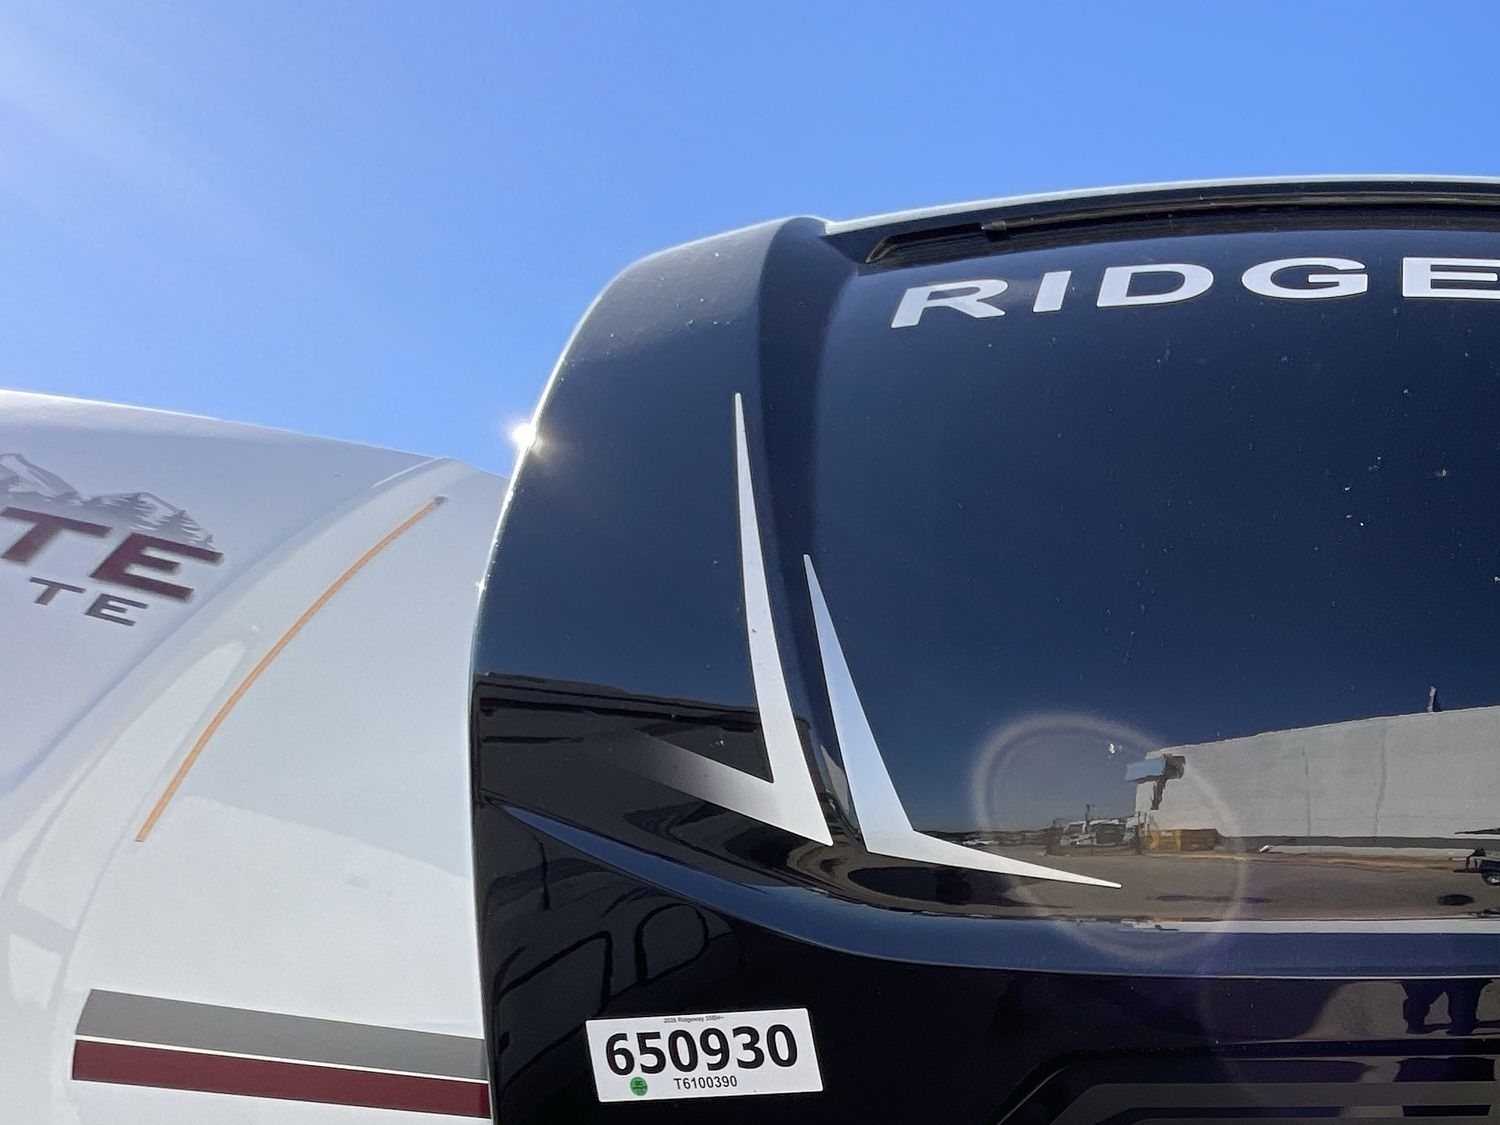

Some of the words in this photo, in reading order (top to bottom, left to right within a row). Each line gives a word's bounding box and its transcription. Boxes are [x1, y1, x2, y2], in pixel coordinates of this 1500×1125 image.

[0, 506, 225, 604] TE
[29, 576, 151, 628] TE
[605, 1023, 799, 1077] 650930
[673, 1075, 738, 1090] T6100390
